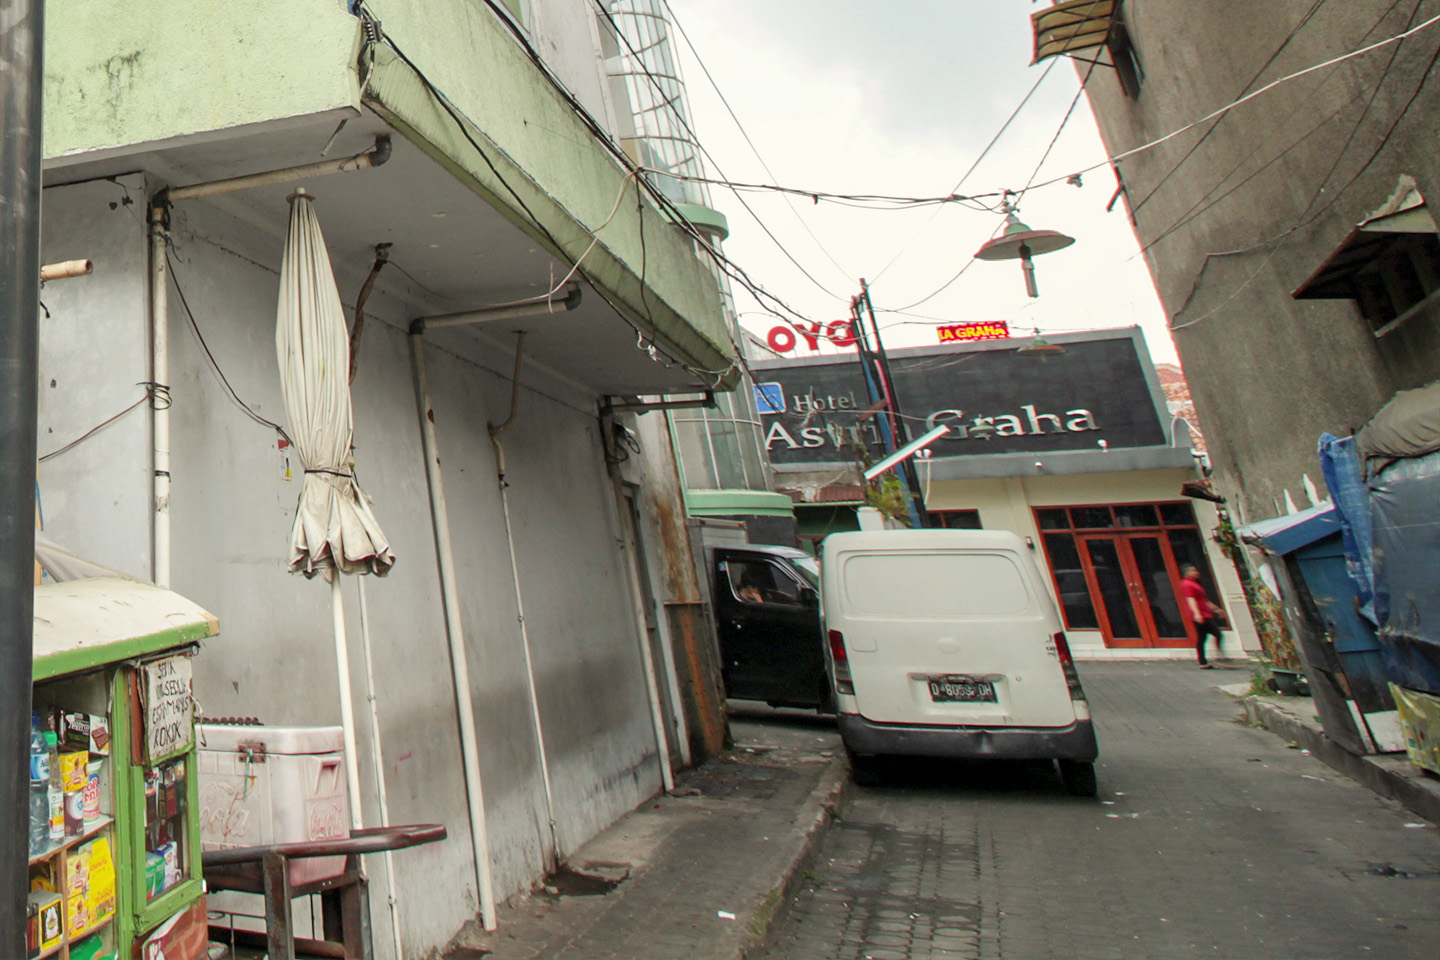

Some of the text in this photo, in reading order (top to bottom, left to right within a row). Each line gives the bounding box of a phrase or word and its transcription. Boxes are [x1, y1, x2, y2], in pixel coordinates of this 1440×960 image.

[767, 320, 858, 353] OYO
[793, 392, 858, 413] Hotel
[925, 404, 1102, 440] Graha
